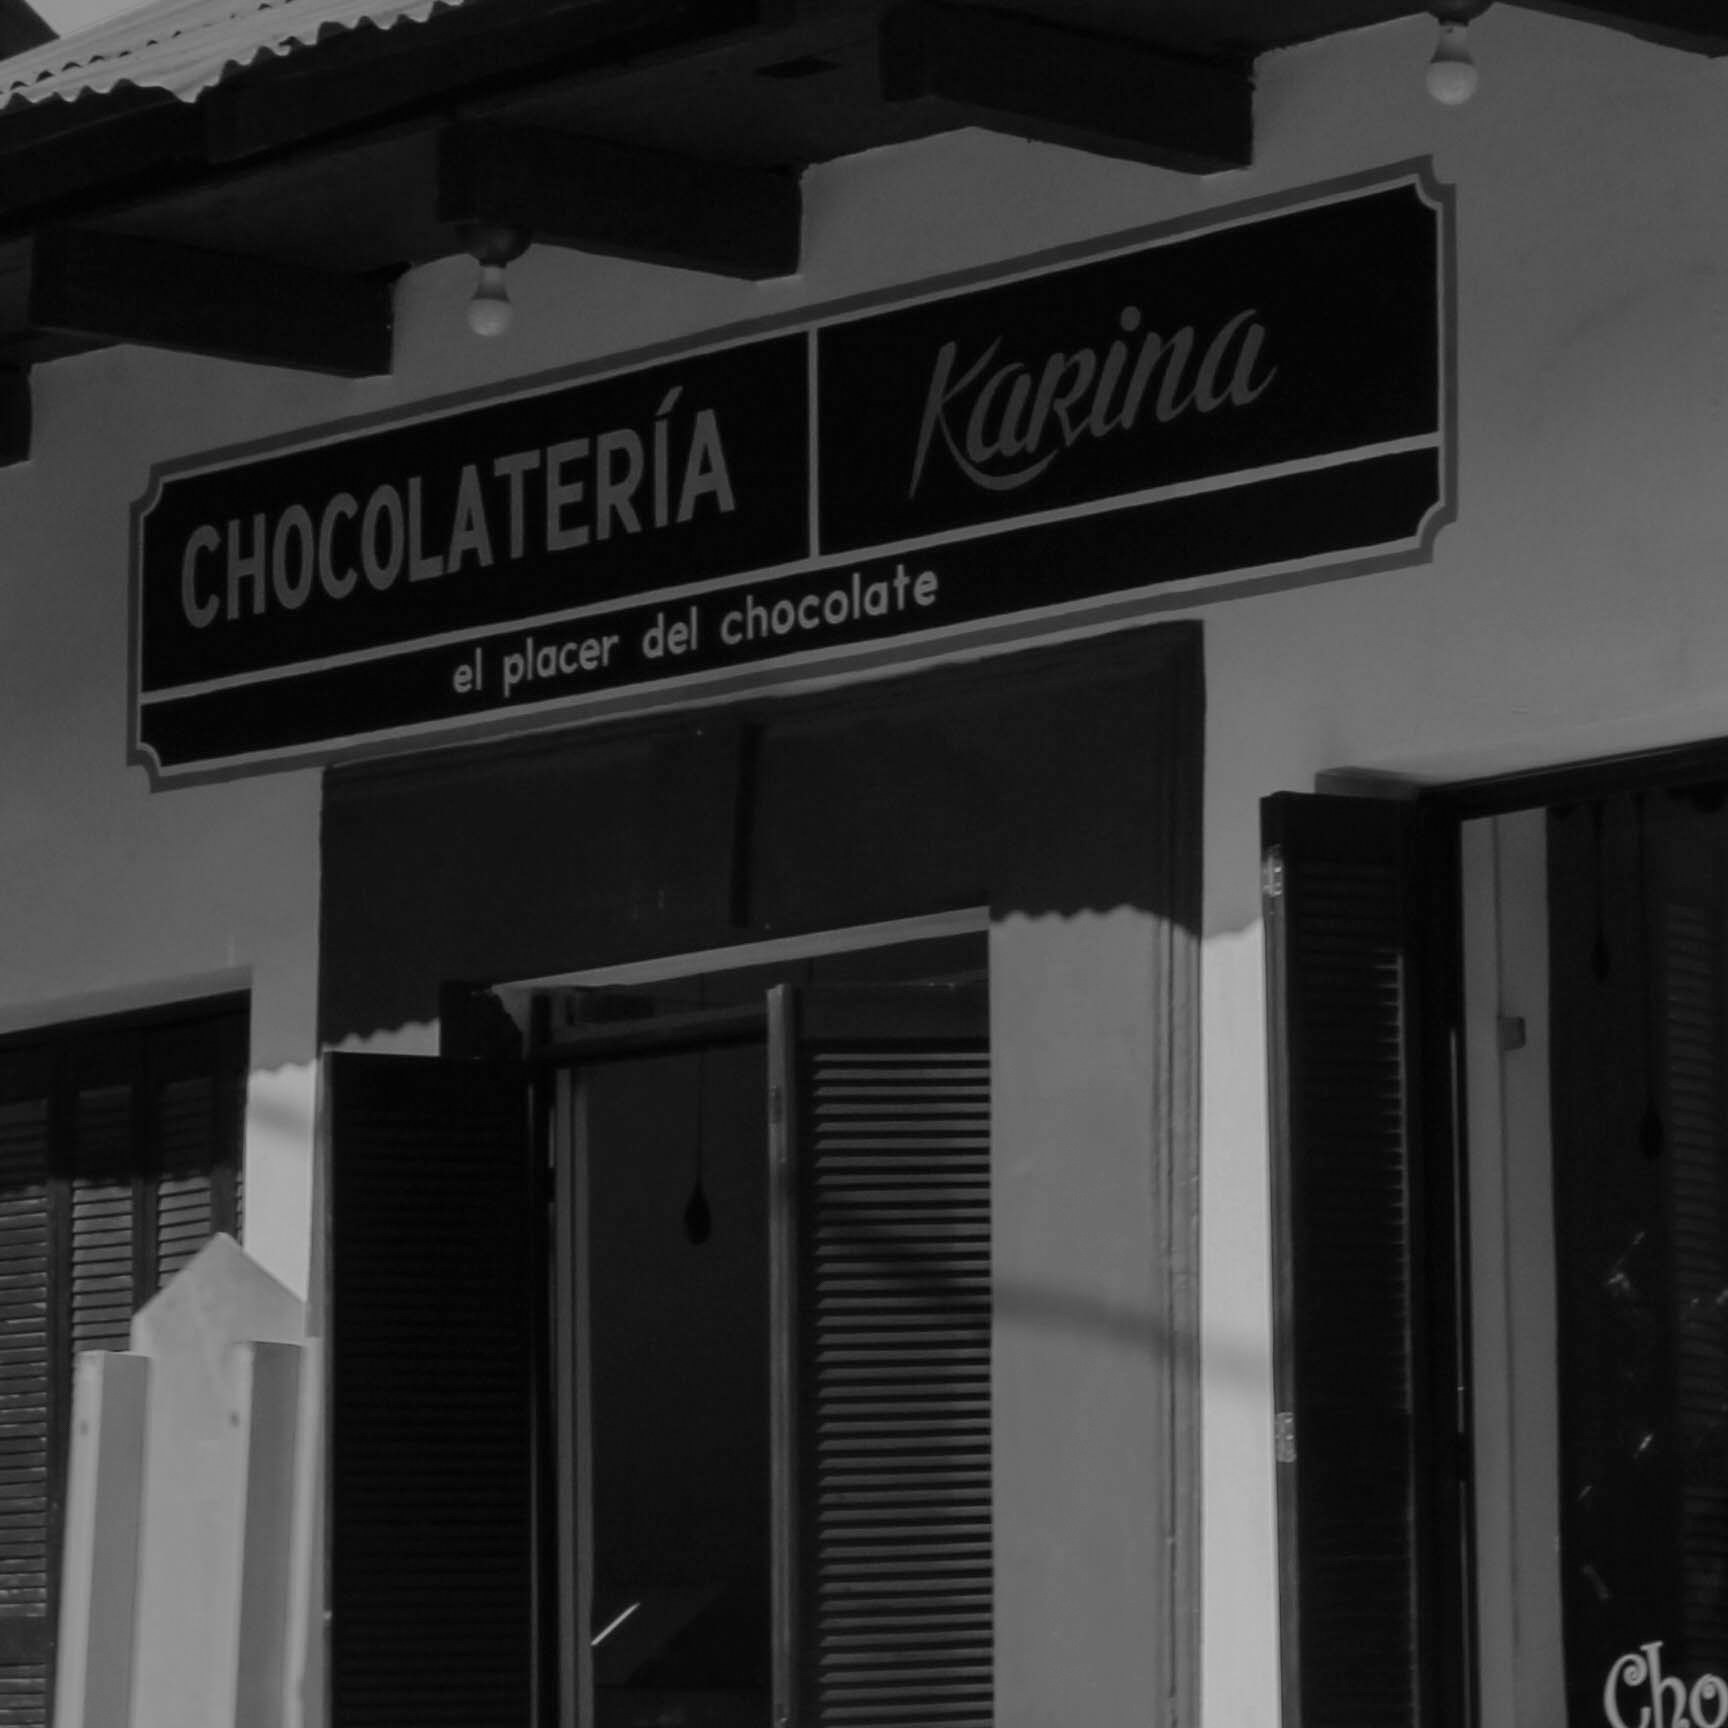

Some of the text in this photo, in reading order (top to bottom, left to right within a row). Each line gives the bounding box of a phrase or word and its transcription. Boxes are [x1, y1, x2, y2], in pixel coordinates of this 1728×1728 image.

[181, 385, 736, 629] CHOCOLATERÍA
[452, 563, 939, 699] el placer del chocolate
